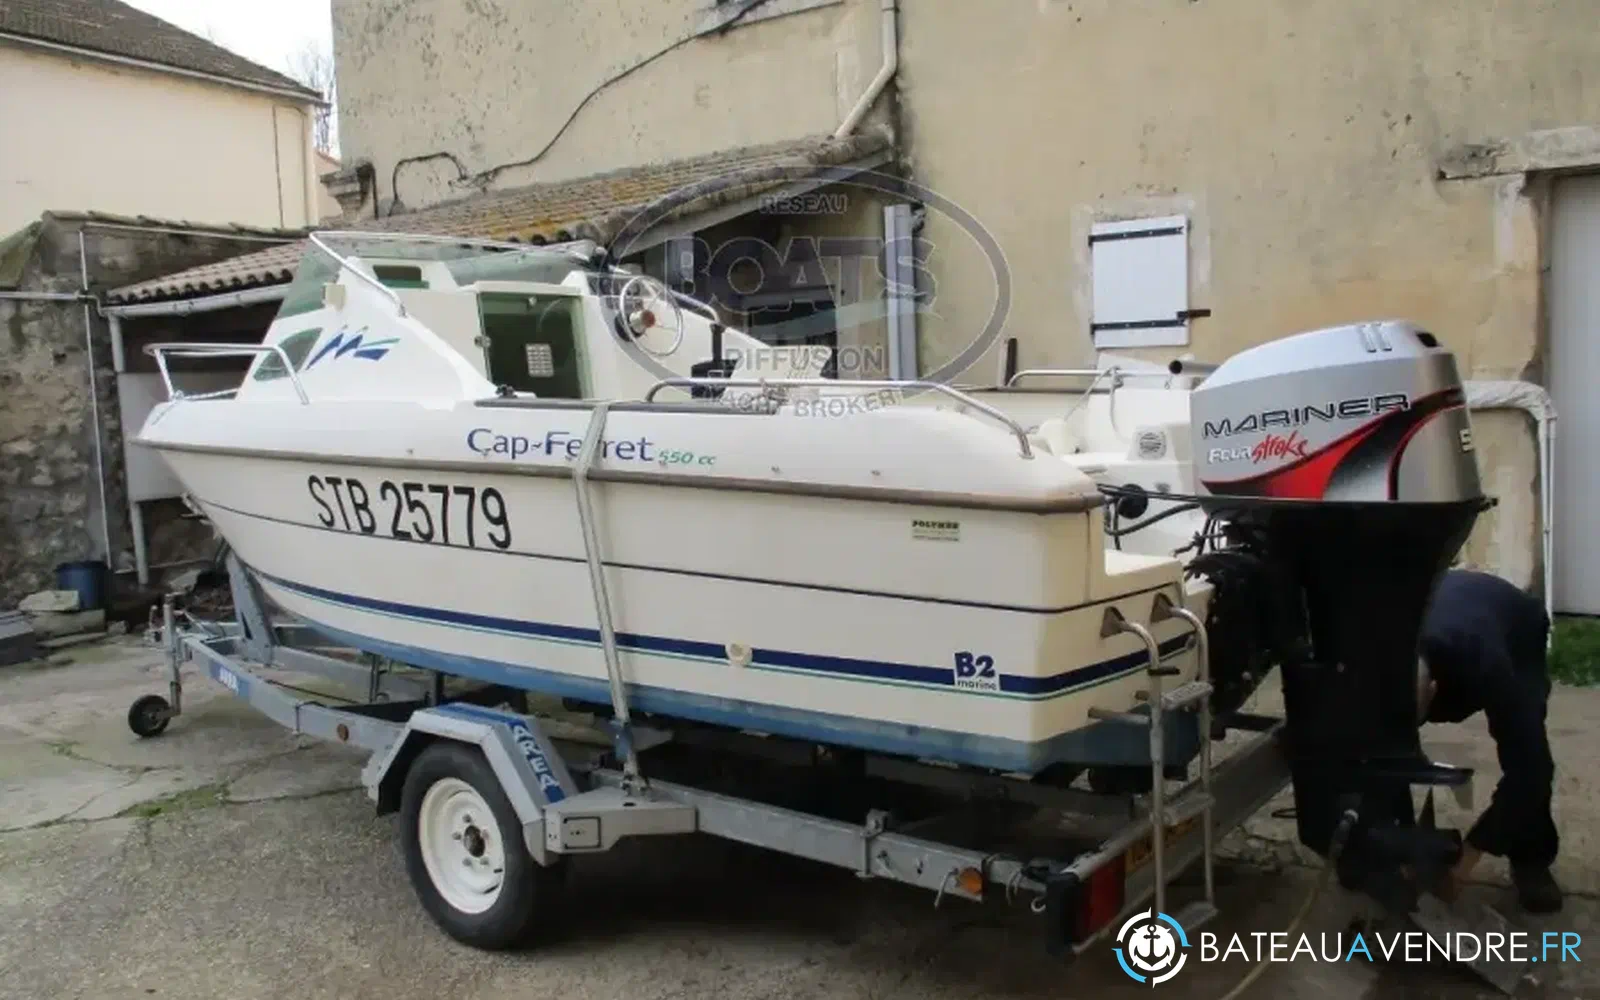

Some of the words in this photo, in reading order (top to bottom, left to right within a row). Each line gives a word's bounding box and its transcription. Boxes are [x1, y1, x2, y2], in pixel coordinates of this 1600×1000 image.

[1203, 394, 1411, 438] MARINER
[467, 428, 654, 461] Cap-Feret
[657, 451, 694, 465] 550
[307, 474, 377, 535] STB
[380, 480, 512, 550] 25779
[955, 651, 995, 678] B2
[957, 680, 997, 691] marine
